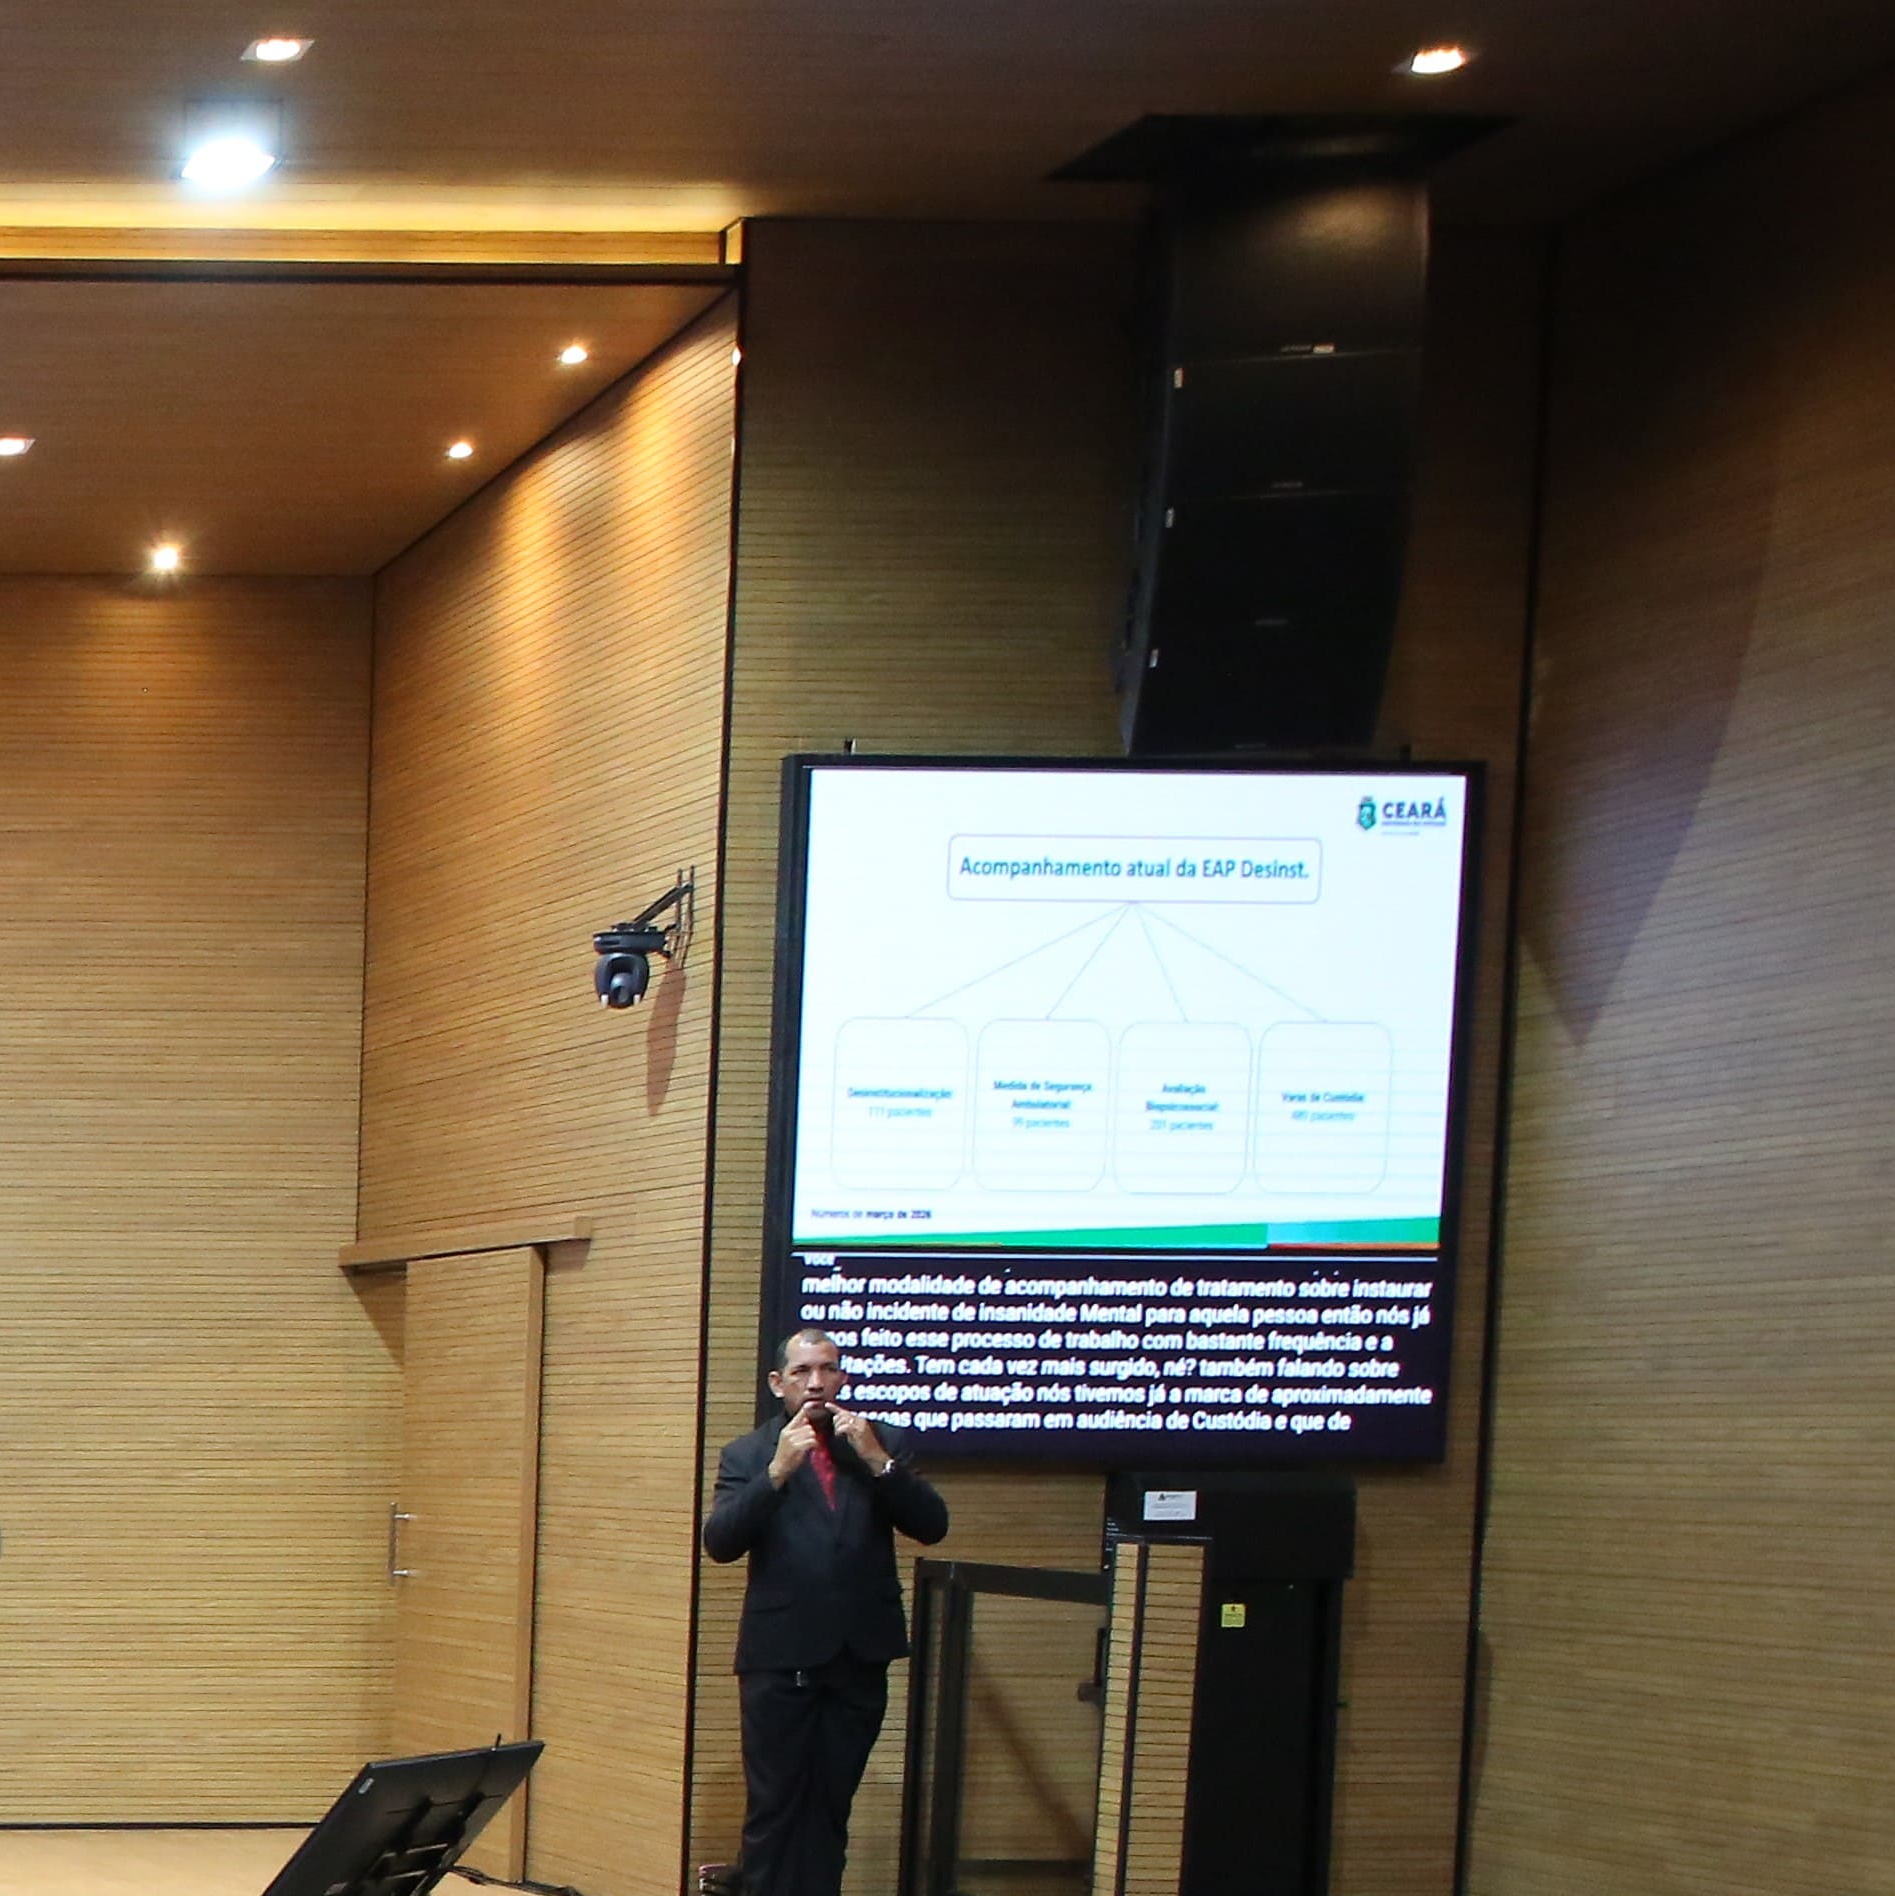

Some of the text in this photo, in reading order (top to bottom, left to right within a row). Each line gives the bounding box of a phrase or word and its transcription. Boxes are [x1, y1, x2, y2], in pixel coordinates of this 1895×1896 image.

[1382, 796, 1447, 820] CEARÁ
[960, 856, 1310, 881] Acompanhamento atual da EAP Desinst.
[802, 1273, 1433, 1301] melhor modalidade de acompanhamento de tratamento sobre instaurar
[800, 1299, 1431, 1329] ou não incidente de insanidade Mental para aquela pessoa então nós já
[861, 1327, 903, 1347] feito
[905, 1331, 950, 1348] esse
[951, 1332, 1036, 1353] processo
[1038, 1328, 1063, 1349] de
[1065, 1329, 1140, 1350] trabalho
[1141, 1334, 1184, 1350] com
[1185, 1330, 1266, 1350] bastante
[1268, 1330, 1363, 1356] frequência
[1364, 1335, 1379, 1351] e
[1380, 1335, 1394, 1351] a
